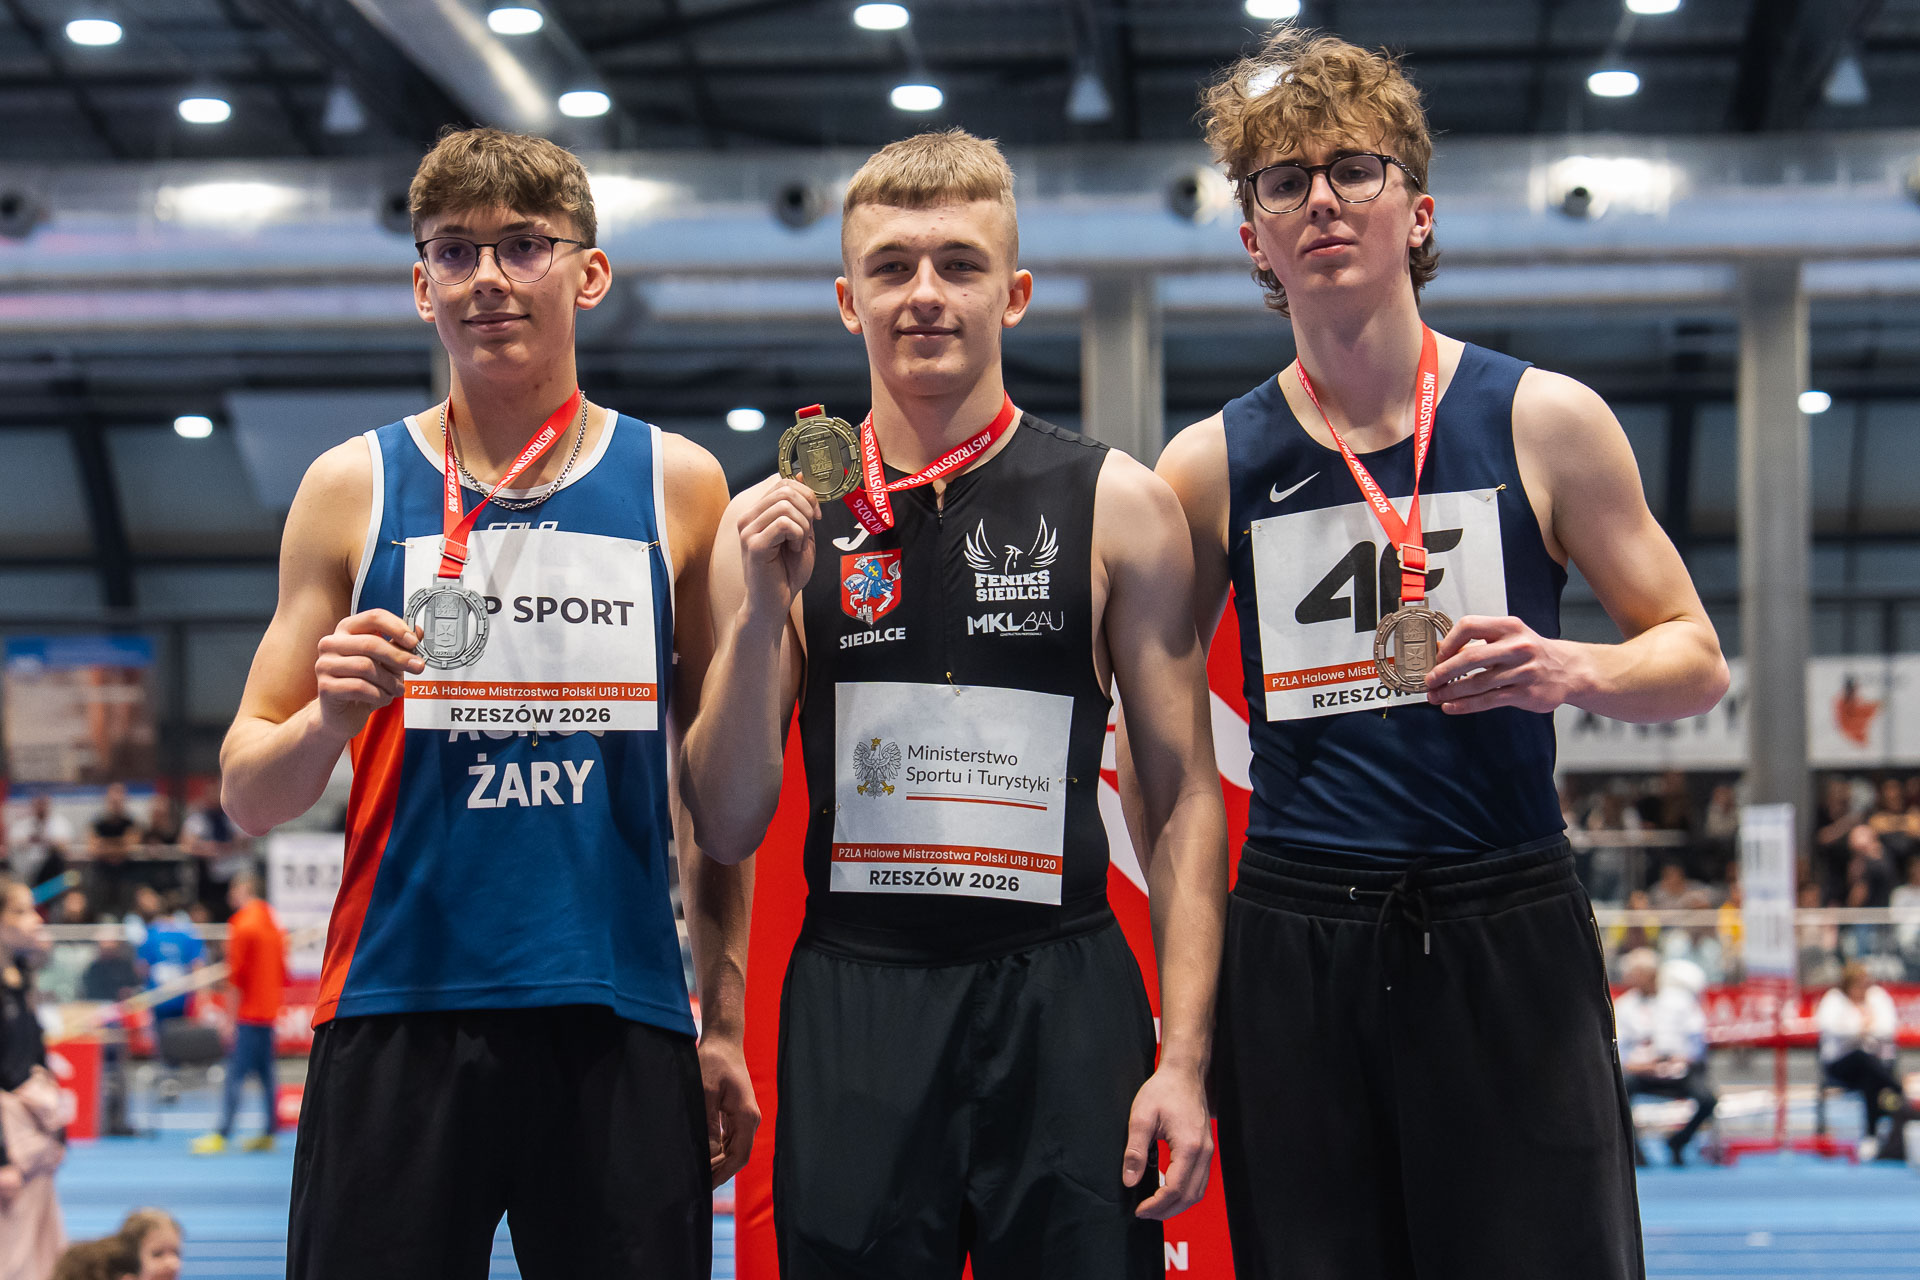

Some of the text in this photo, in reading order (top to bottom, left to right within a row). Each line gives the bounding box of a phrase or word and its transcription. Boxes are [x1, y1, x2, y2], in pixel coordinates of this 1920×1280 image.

[1419, 372, 1435, 442] MISTRZOSTWA
[508, 425, 556, 475] MISTRZOSTWA
[864, 427, 877, 461] POLSKI
[922, 431, 992, 478] MISTRZOSTWA
[1350, 459, 1390, 514] POLSKI 2026
[853, 498, 877, 526] 2026
[975, 569, 1050, 588] FENIKS
[976, 585, 1050, 602] SIEDLCE
[513, 596, 634, 626] SPORT
[839, 627, 906, 650] SIEDLCE
[411, 684, 650, 698] PZLA Halowe Mistrzostwa Polski U18 i U20
[1272, 675, 1299, 688] PZLA
[1302, 669, 1345, 685] Halowe
[450, 704, 611, 723] RZESZÓW 2026
[907, 744, 1018, 766] Ministerstwo
[467, 753, 595, 809] ŻARY
[906, 766, 1050, 792] Sportu i Turystyki
[838, 848, 861, 858] PZLA
[863, 848, 900, 859] Halowe
[903, 849, 971, 861] Mistrzostwa
[974, 852, 1008, 864] Polski
[1010, 855, 1028, 866] U18
[1036, 858, 1057, 870] U20
[869, 867, 1020, 892] RZESZÓW 2026
